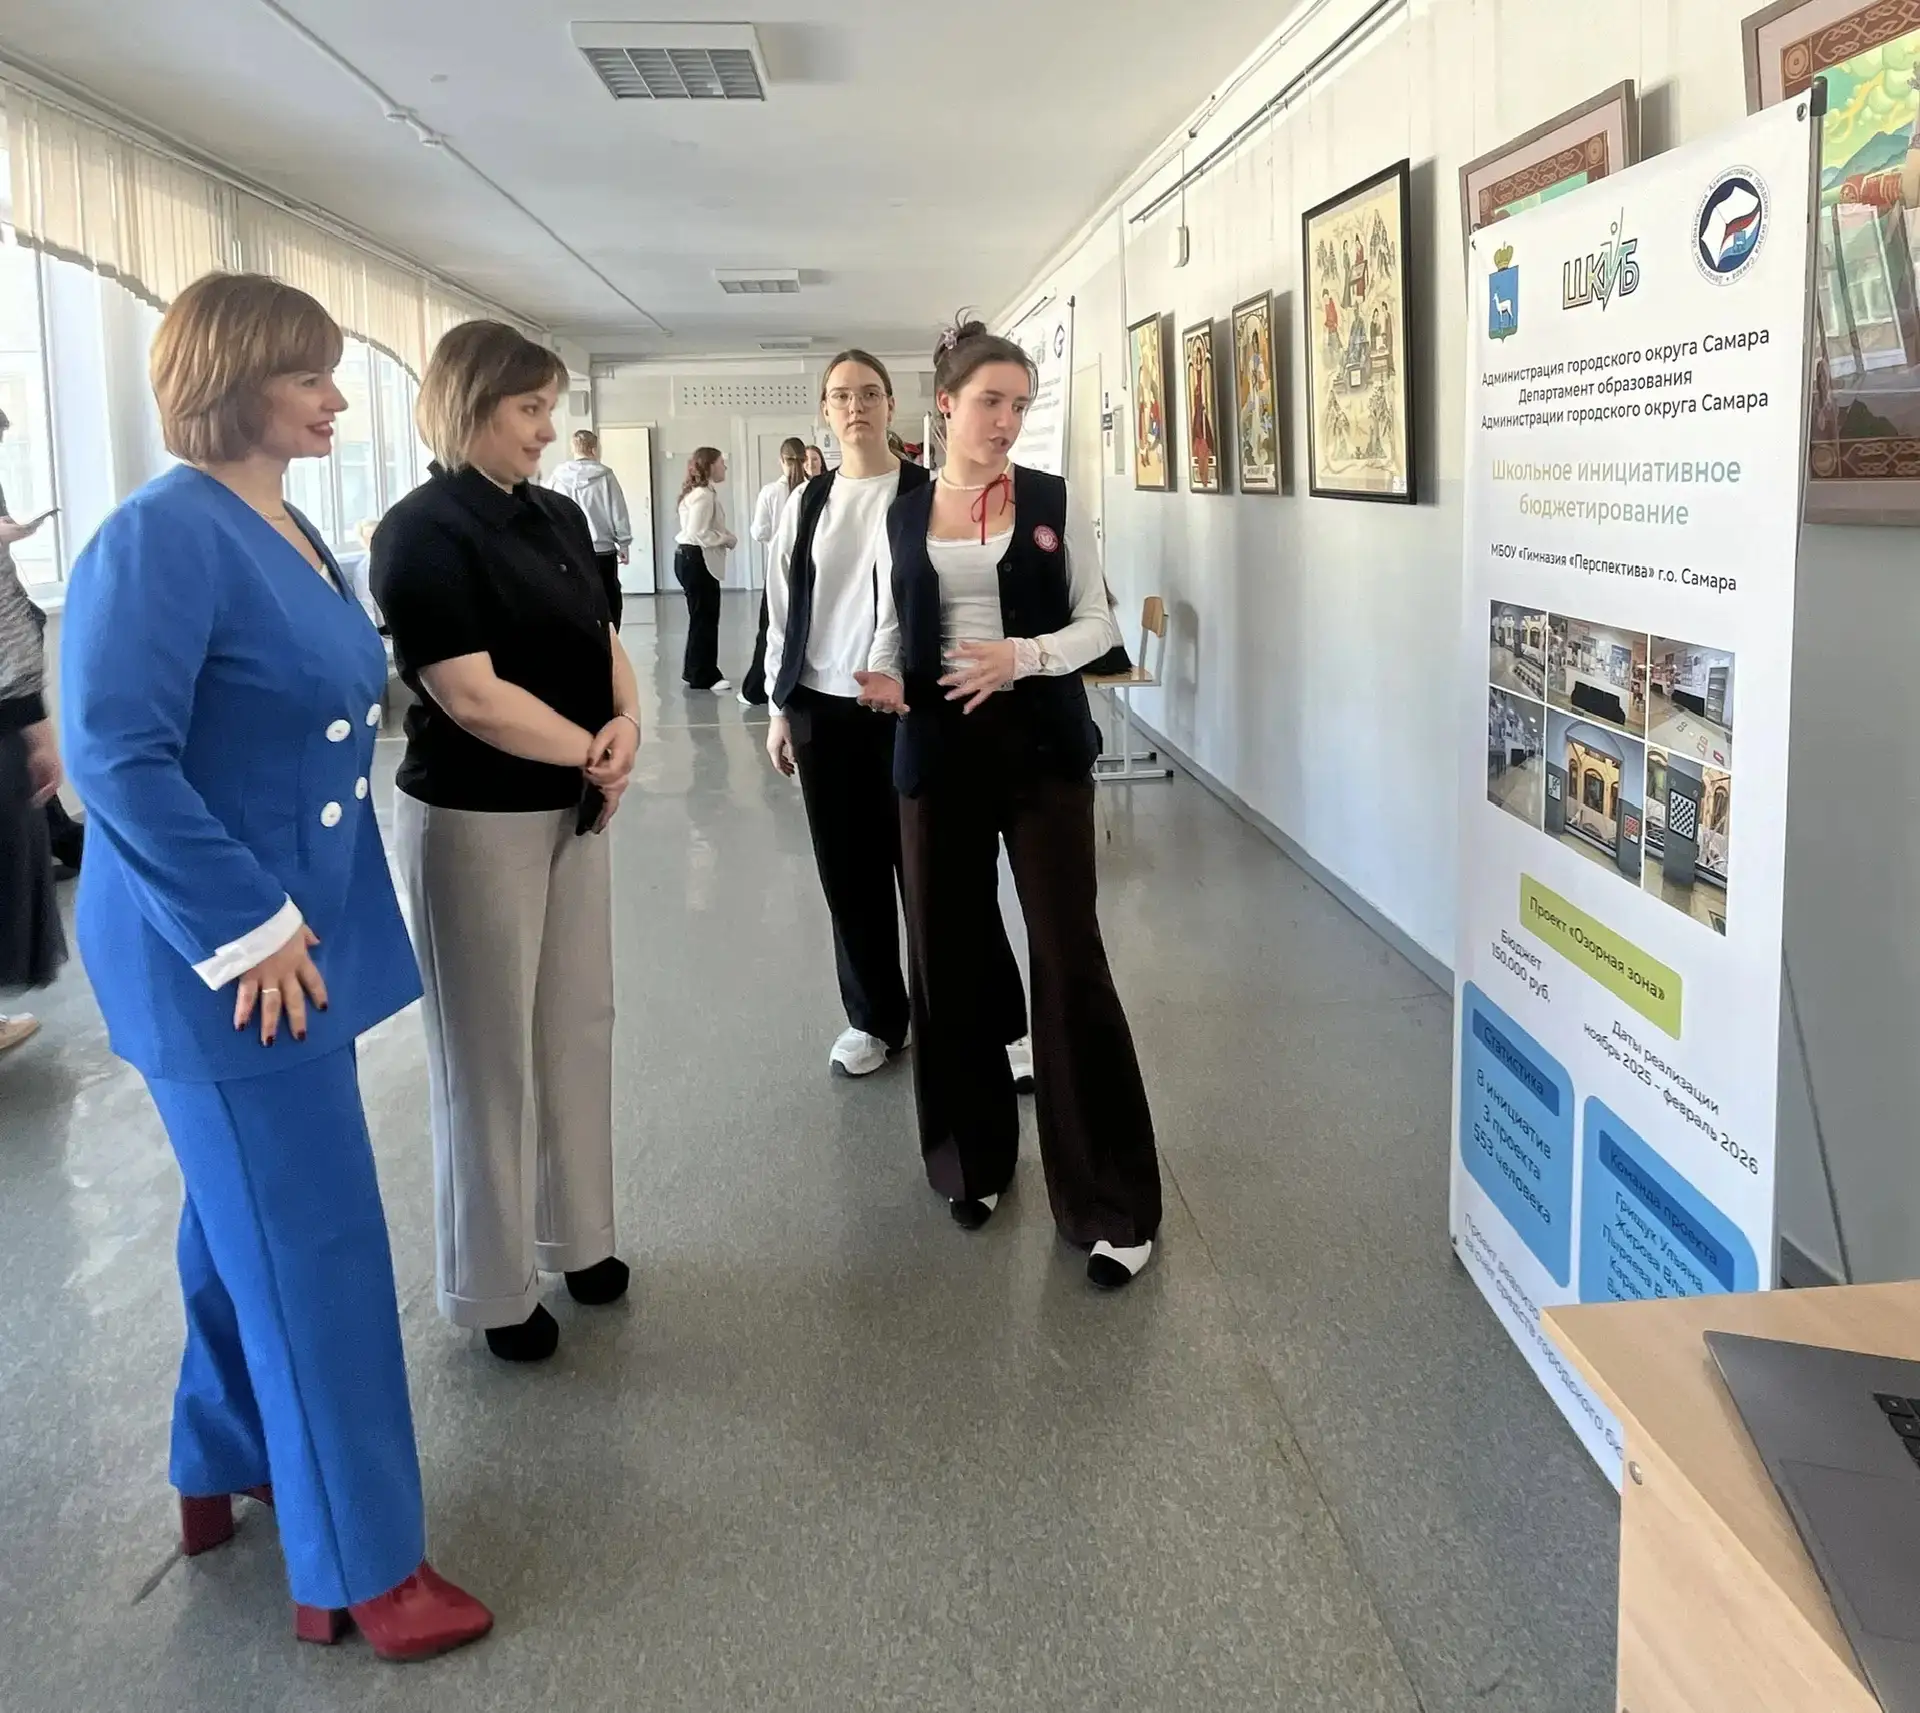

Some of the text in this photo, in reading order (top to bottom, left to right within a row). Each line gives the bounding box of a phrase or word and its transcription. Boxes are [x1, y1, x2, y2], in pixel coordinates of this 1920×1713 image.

[1481, 328, 1770, 387] Администрация городского округа Самара
[1518, 370, 1693, 405] Департамент образования
[1481, 391, 1769, 430] Администрации городского округа Самара
[1492, 459, 1742, 486] Школьное инициативное
[1519, 493, 1690, 526] бюджетирование
[1490, 543, 1737, 594] МБОУ «Гимназия «Перспектива» г.о. Самара
[1491, 942, 1551, 1003] 150.000 руб.
[1501, 928, 1542, 971] Бюджет
[1529, 896, 1666, 1001] Проект «Озорная зона»
[1483, 1026, 1545, 1096] Статистика
[1612, 1020, 1720, 1116] Даты реализации
[1476, 1068, 1552, 1160] 8 инициатив
[1584, 1023, 1622, 1061] ноябрь
[1622, 1053, 1652, 1087] 2025
[1663, 1087, 1718, 1142] февраль
[1720, 1132, 1759, 1176] 2026
[1482, 1104, 1542, 1181] 3 проекта
[1495, 1152, 1552, 1225] человека
[1610, 1150, 1719, 1267] Команда проекта
